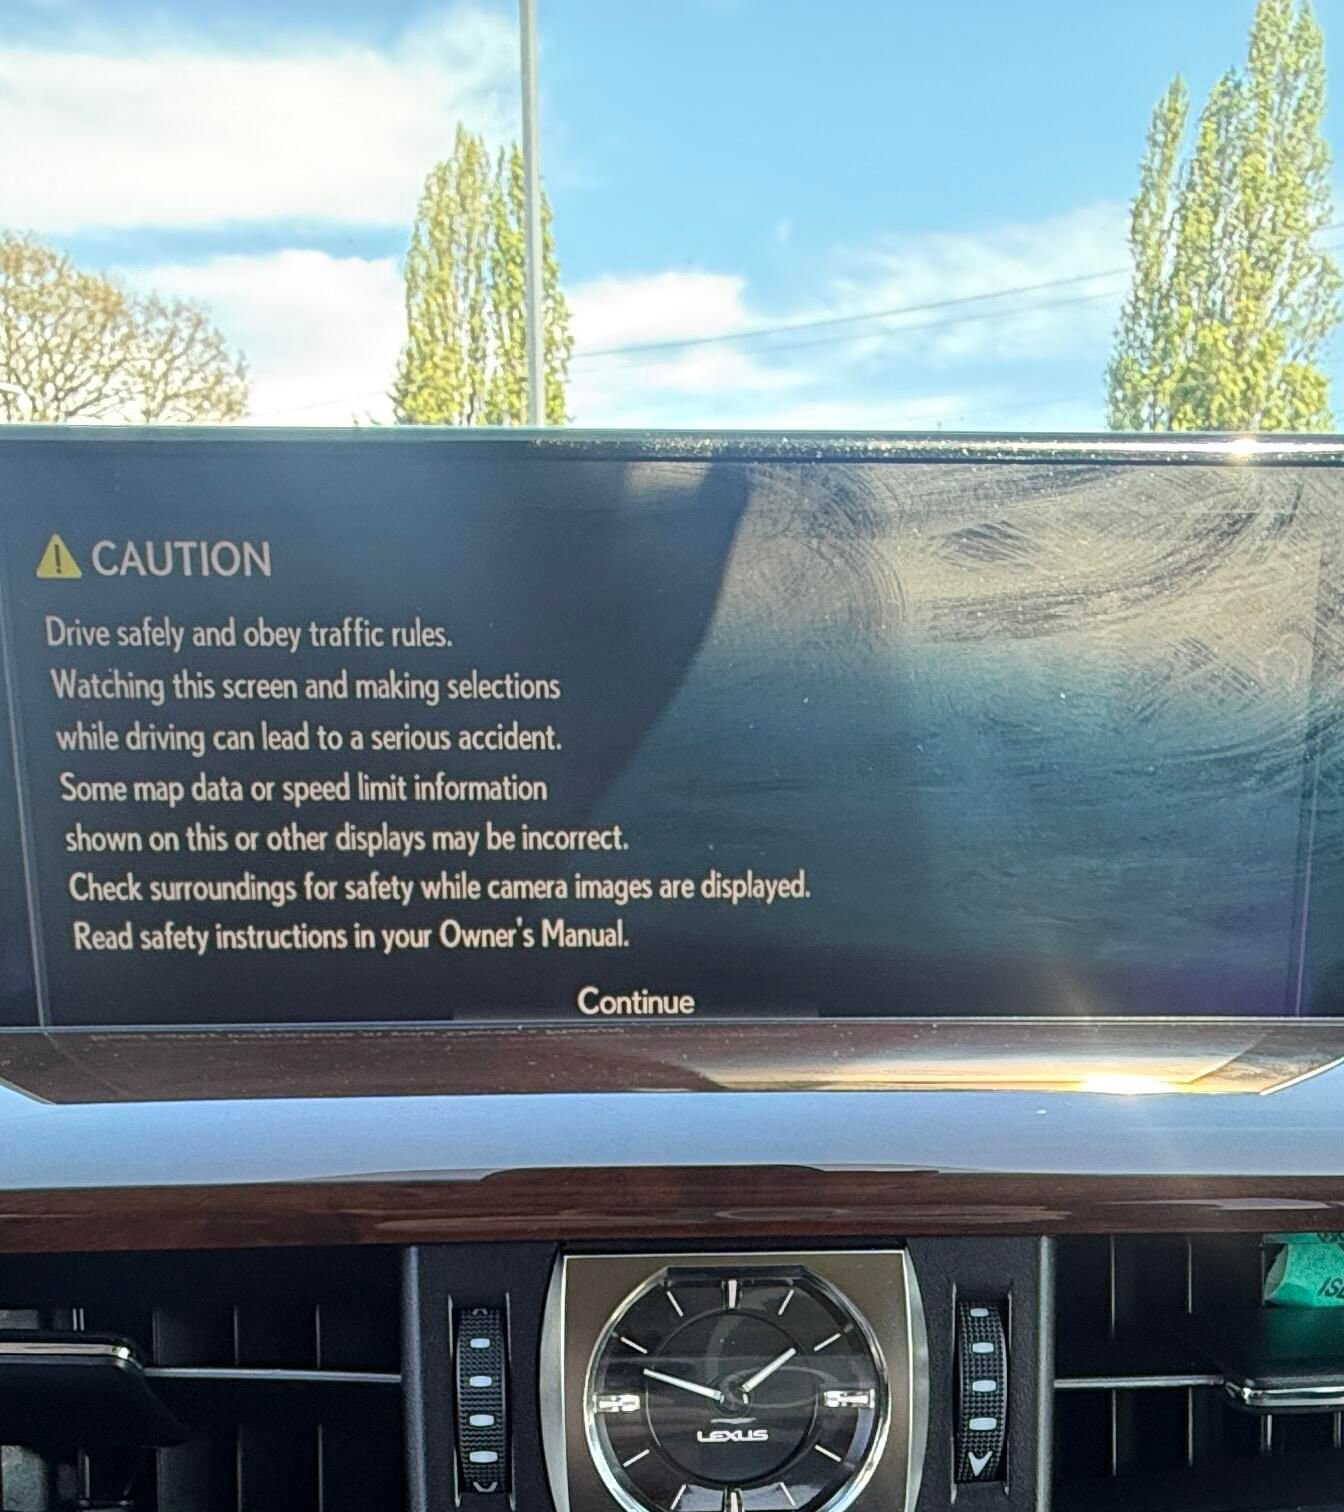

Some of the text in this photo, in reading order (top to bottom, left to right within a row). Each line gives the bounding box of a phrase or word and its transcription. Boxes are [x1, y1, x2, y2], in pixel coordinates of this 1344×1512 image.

[91, 541, 272, 577] CAUTION
[46, 615, 453, 653] Drive safely and obey traffic rules.
[50, 668, 561, 706] Watching this screen and making selections
[56, 720, 562, 758] while driving can lead to a serious accident.
[59, 771, 548, 808] Some map data or speed limit information
[65, 821, 630, 858] shown on this or other displays may be incorrect.
[68, 868, 811, 908] Check surroundings for safety while camera images are displayed.
[73, 916, 630, 956] Read safety instructions in your Owner's Manual.
[577, 985, 696, 1015] Continue
[696, 1429, 770, 1443] LEXUS
